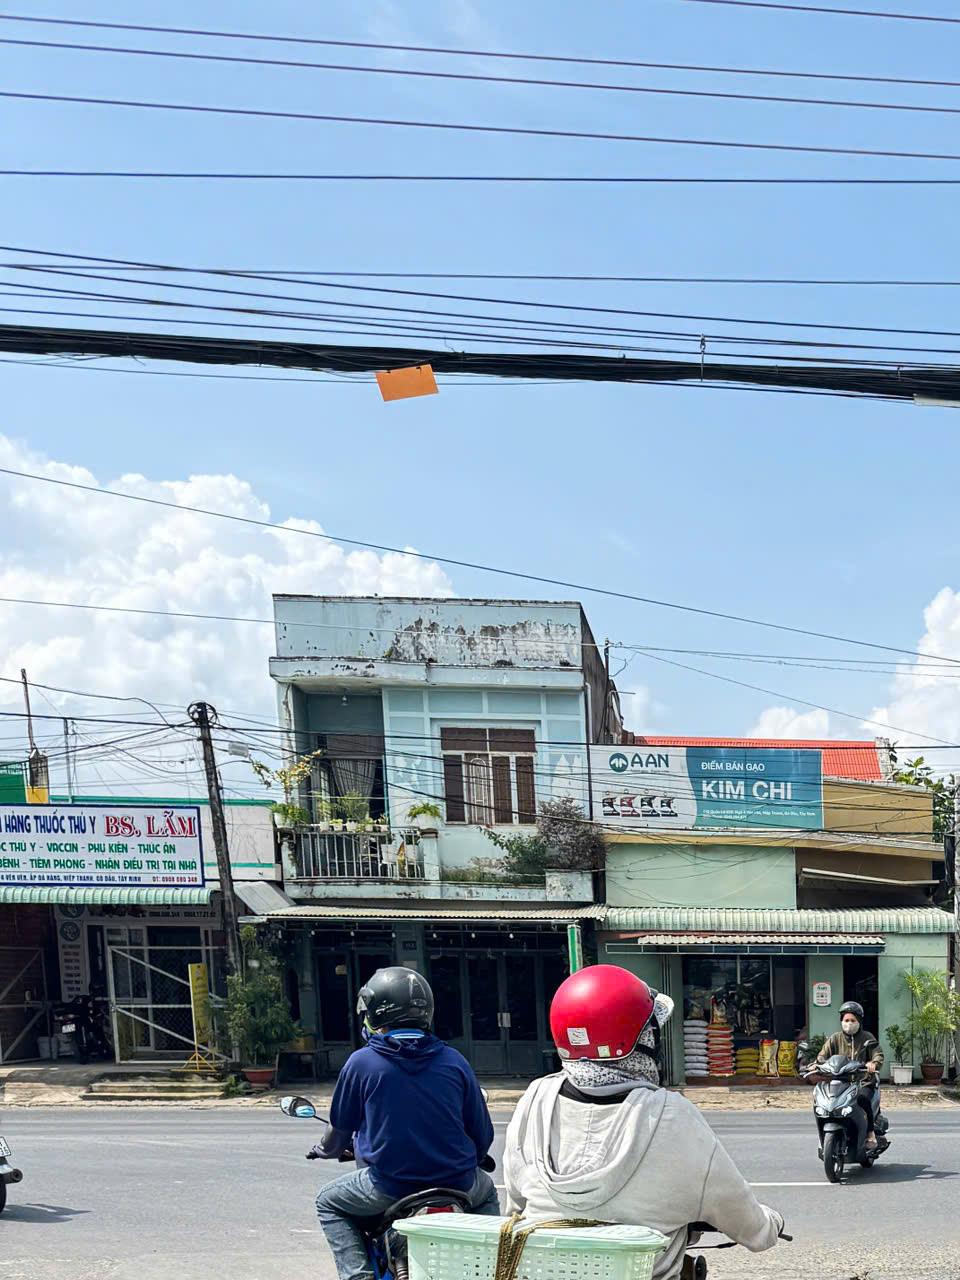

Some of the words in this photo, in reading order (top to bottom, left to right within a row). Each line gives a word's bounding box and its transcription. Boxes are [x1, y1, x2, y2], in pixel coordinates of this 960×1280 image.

[701, 760, 724, 771] ĐIỂM
[725, 761, 744, 771] BÁN
[745, 763, 766, 773] GẠO
[702, 780, 745, 800] KIM
[752, 780, 793, 800] CHI
[4, 810, 31, 834] HÀNG
[33, 808, 66, 834] THUỐC
[68, 811, 87, 834] THÚ
[89, 815, 96, 834] Y
[103, 815, 141, 837] BS.
[30, 842, 36, 852] Y
[47, 842, 79, 853] VACCIN
